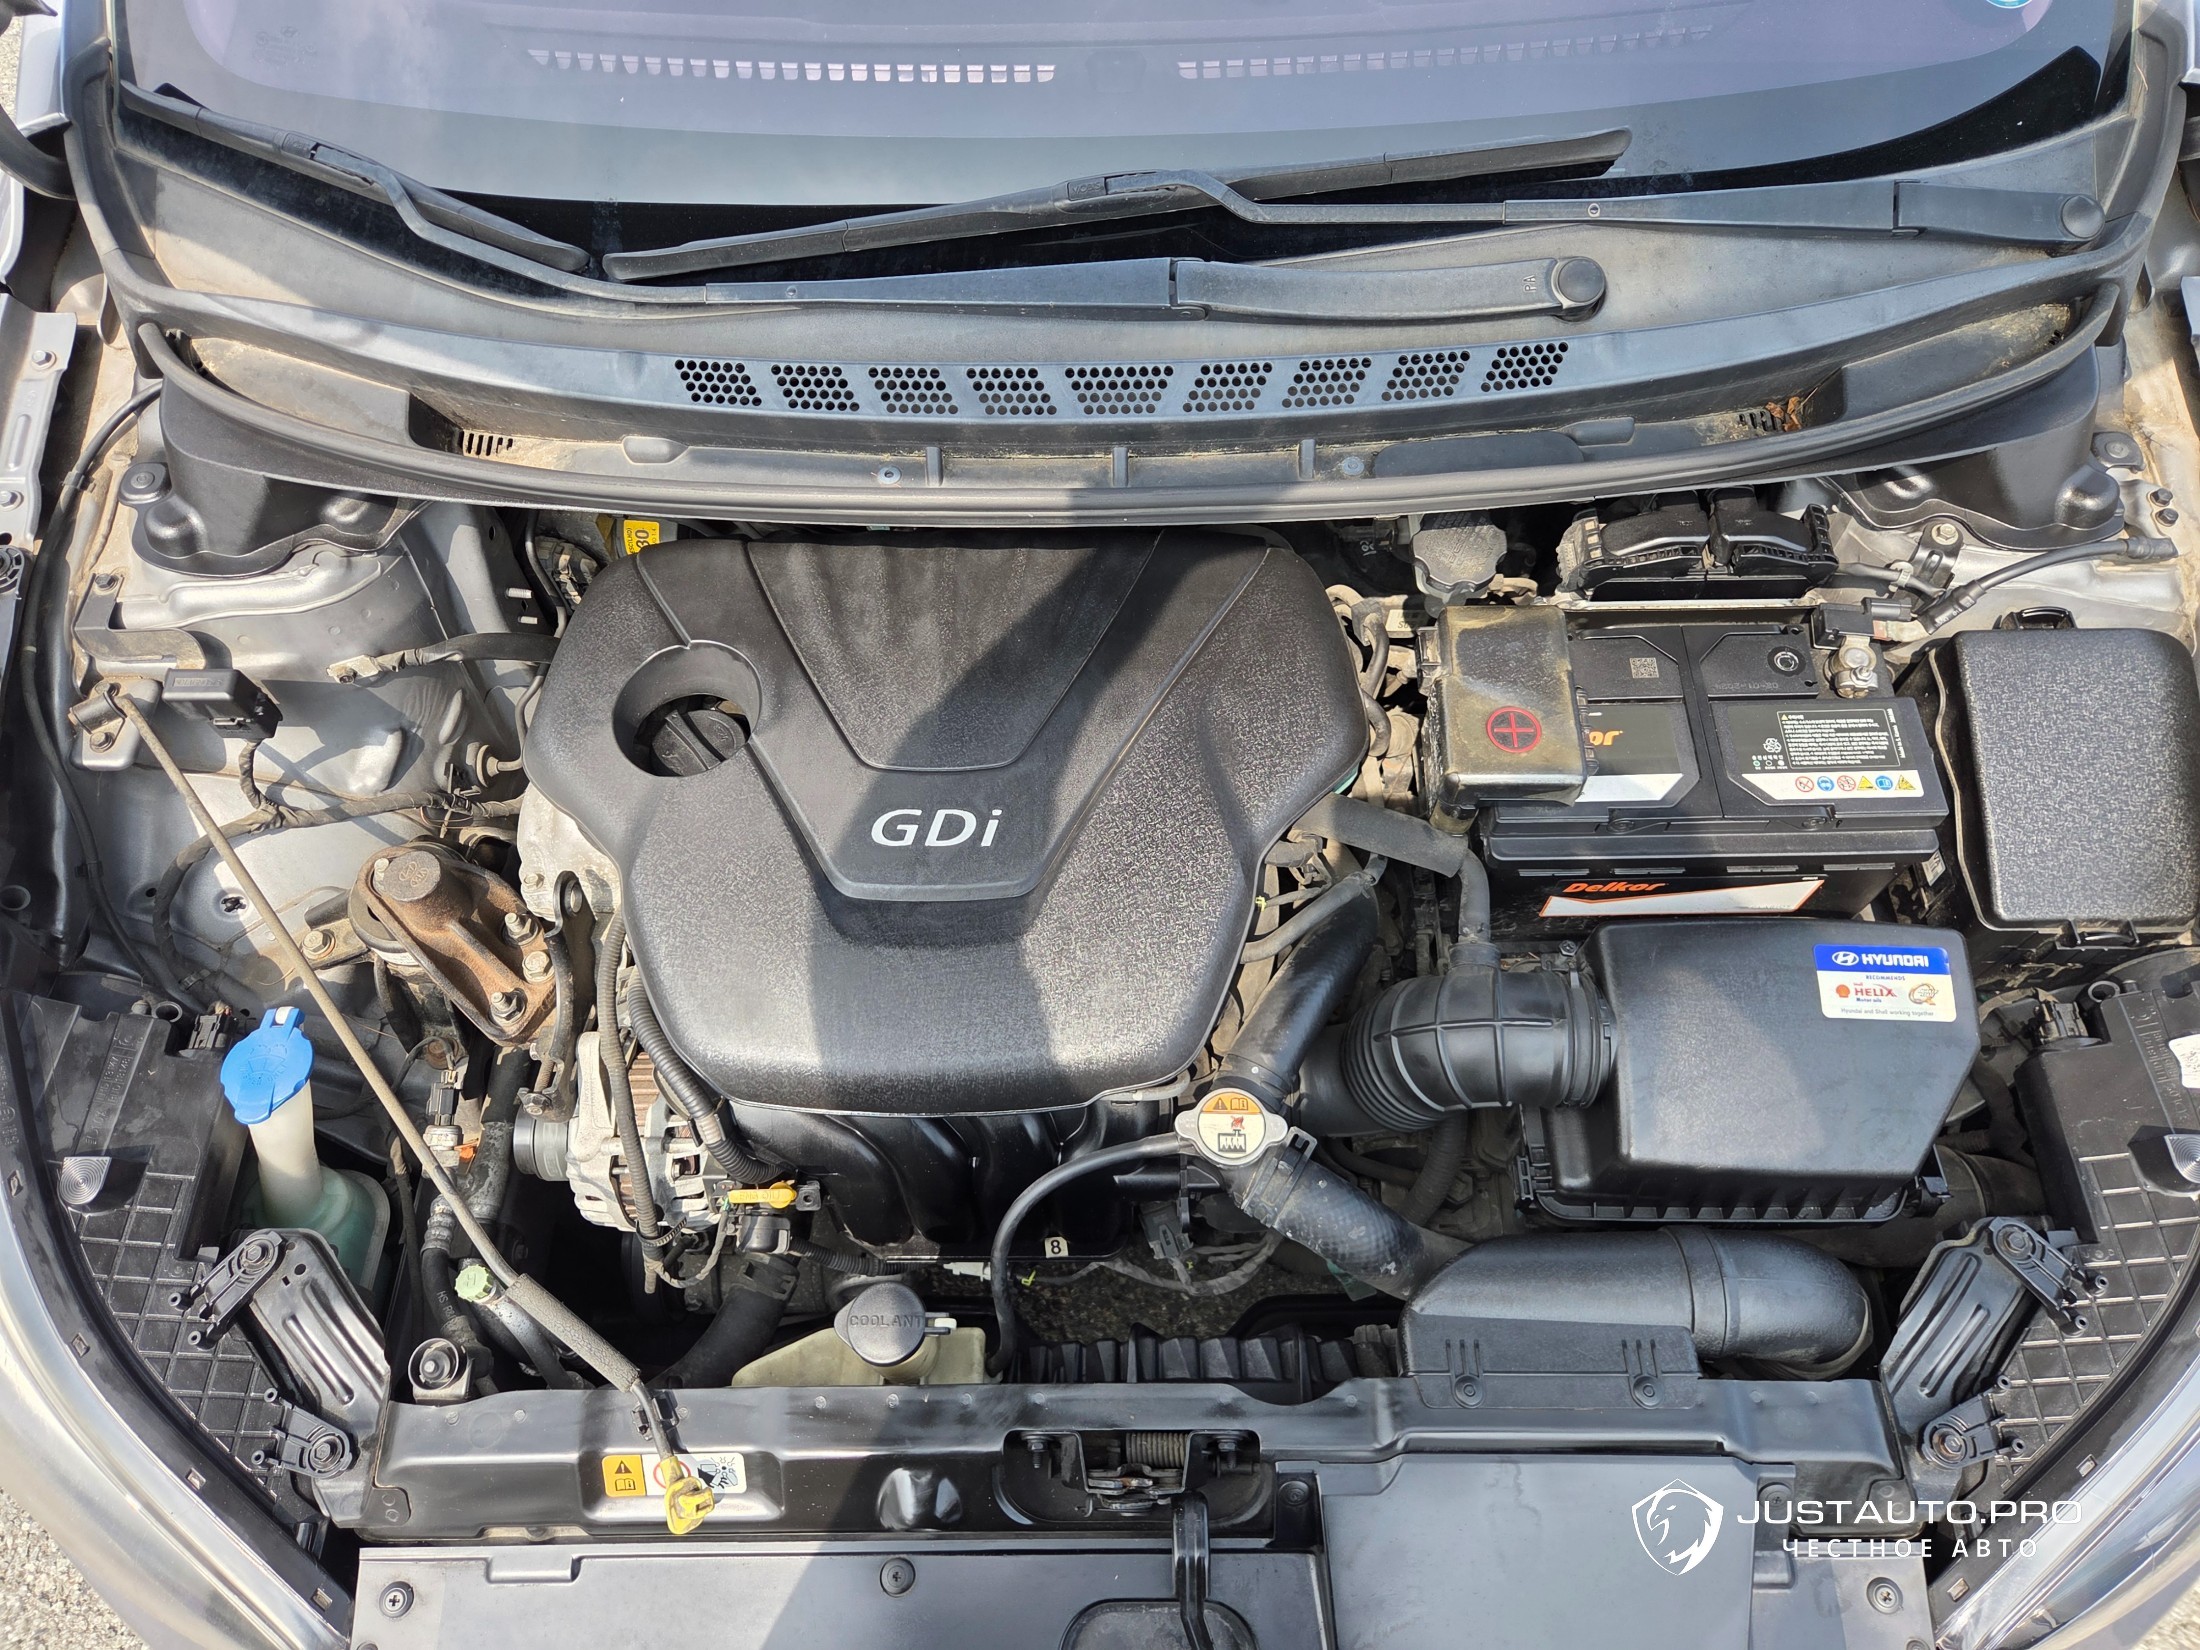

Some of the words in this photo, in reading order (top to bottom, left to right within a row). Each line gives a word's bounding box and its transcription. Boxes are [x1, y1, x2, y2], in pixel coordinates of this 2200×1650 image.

[871, 808, 1003, 847] GDi
[1563, 882, 1665, 893] Delkor
[1862, 953, 1930, 968] HYUNDAI
[1854, 987, 1898, 997] HELIX
[1051, 1239, 1062, 1255] 8
[849, 1314, 925, 1328] COOLANT
